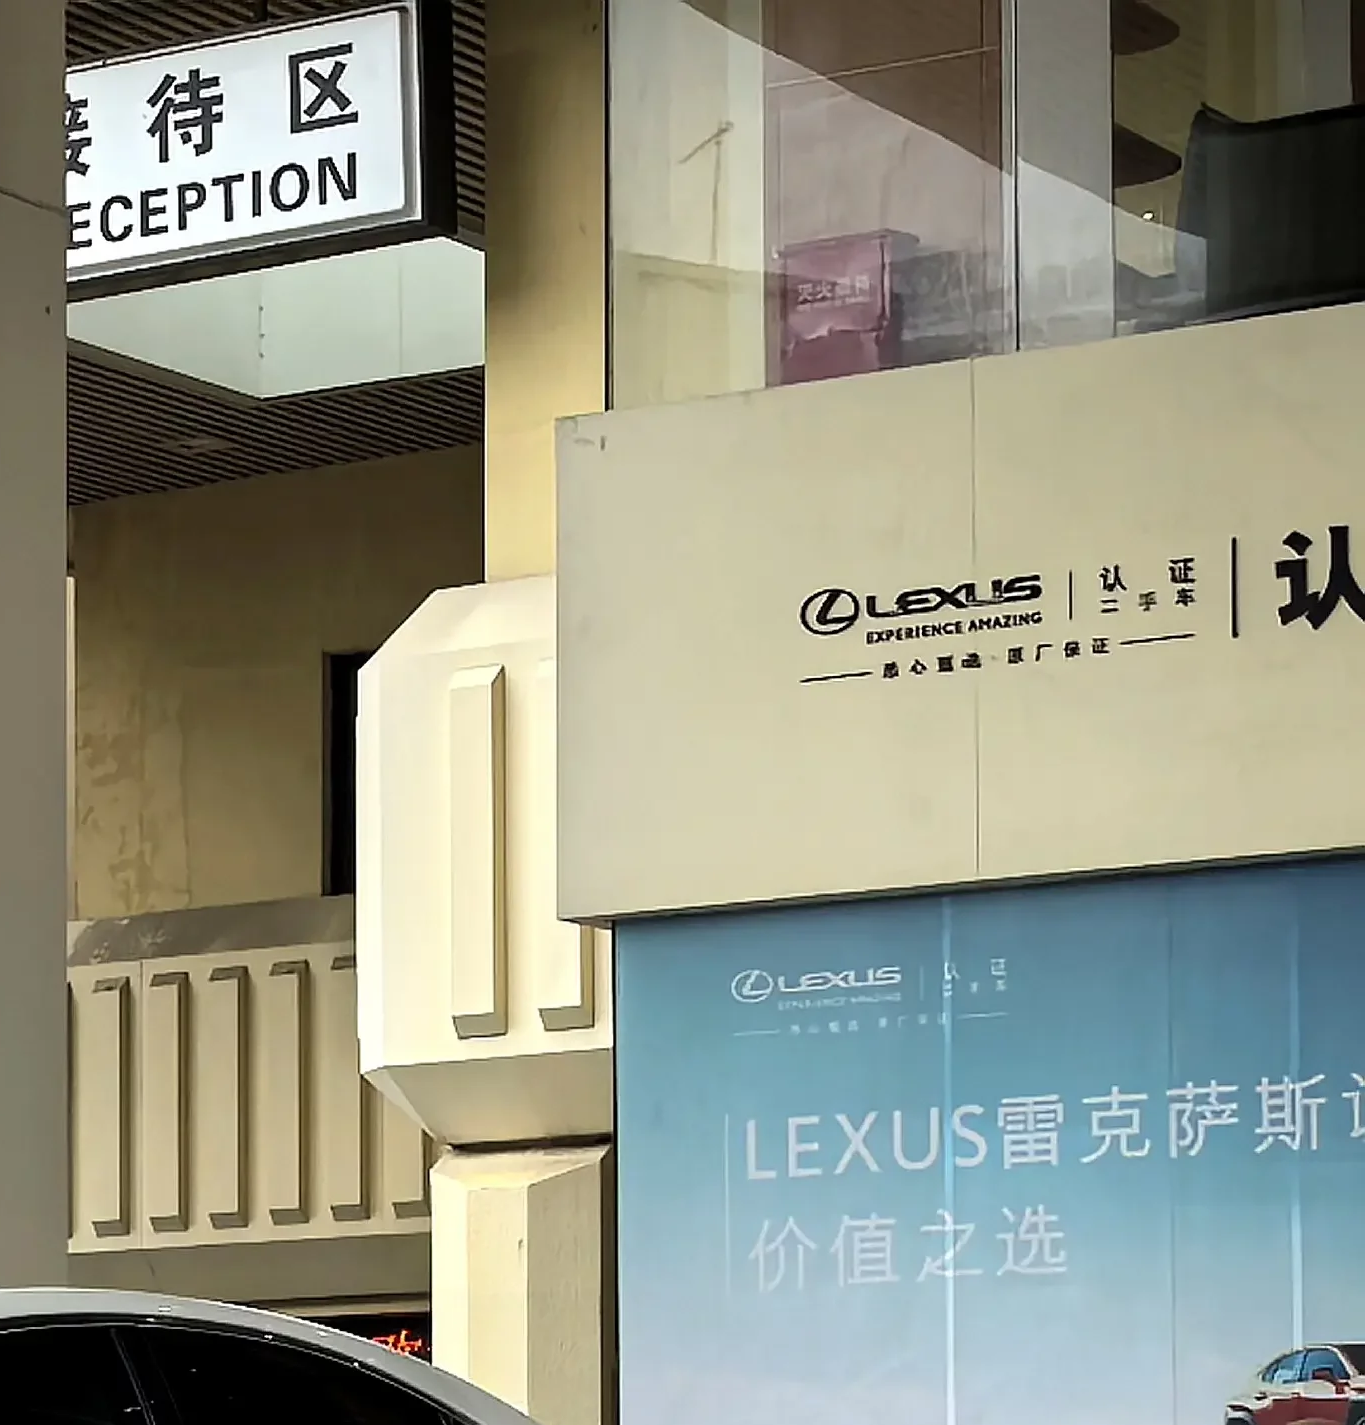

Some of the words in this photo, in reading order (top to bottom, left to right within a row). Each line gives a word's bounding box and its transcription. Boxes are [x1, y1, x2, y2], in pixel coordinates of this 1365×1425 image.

[67, 152, 358, 251] ECEPTION
[1099, 557, 1197, 592] 认证
[1274, 525, 1365, 631] 认
[866, 574, 1042, 619] LEXUS
[1100, 588, 1197, 614] 二手车
[866, 620, 963, 645] EXPERIENCE
[967, 610, 1043, 633] AMAZING
[777, 966, 901, 993] LEXUS
[749, 1203, 1069, 1293] 价值之选
